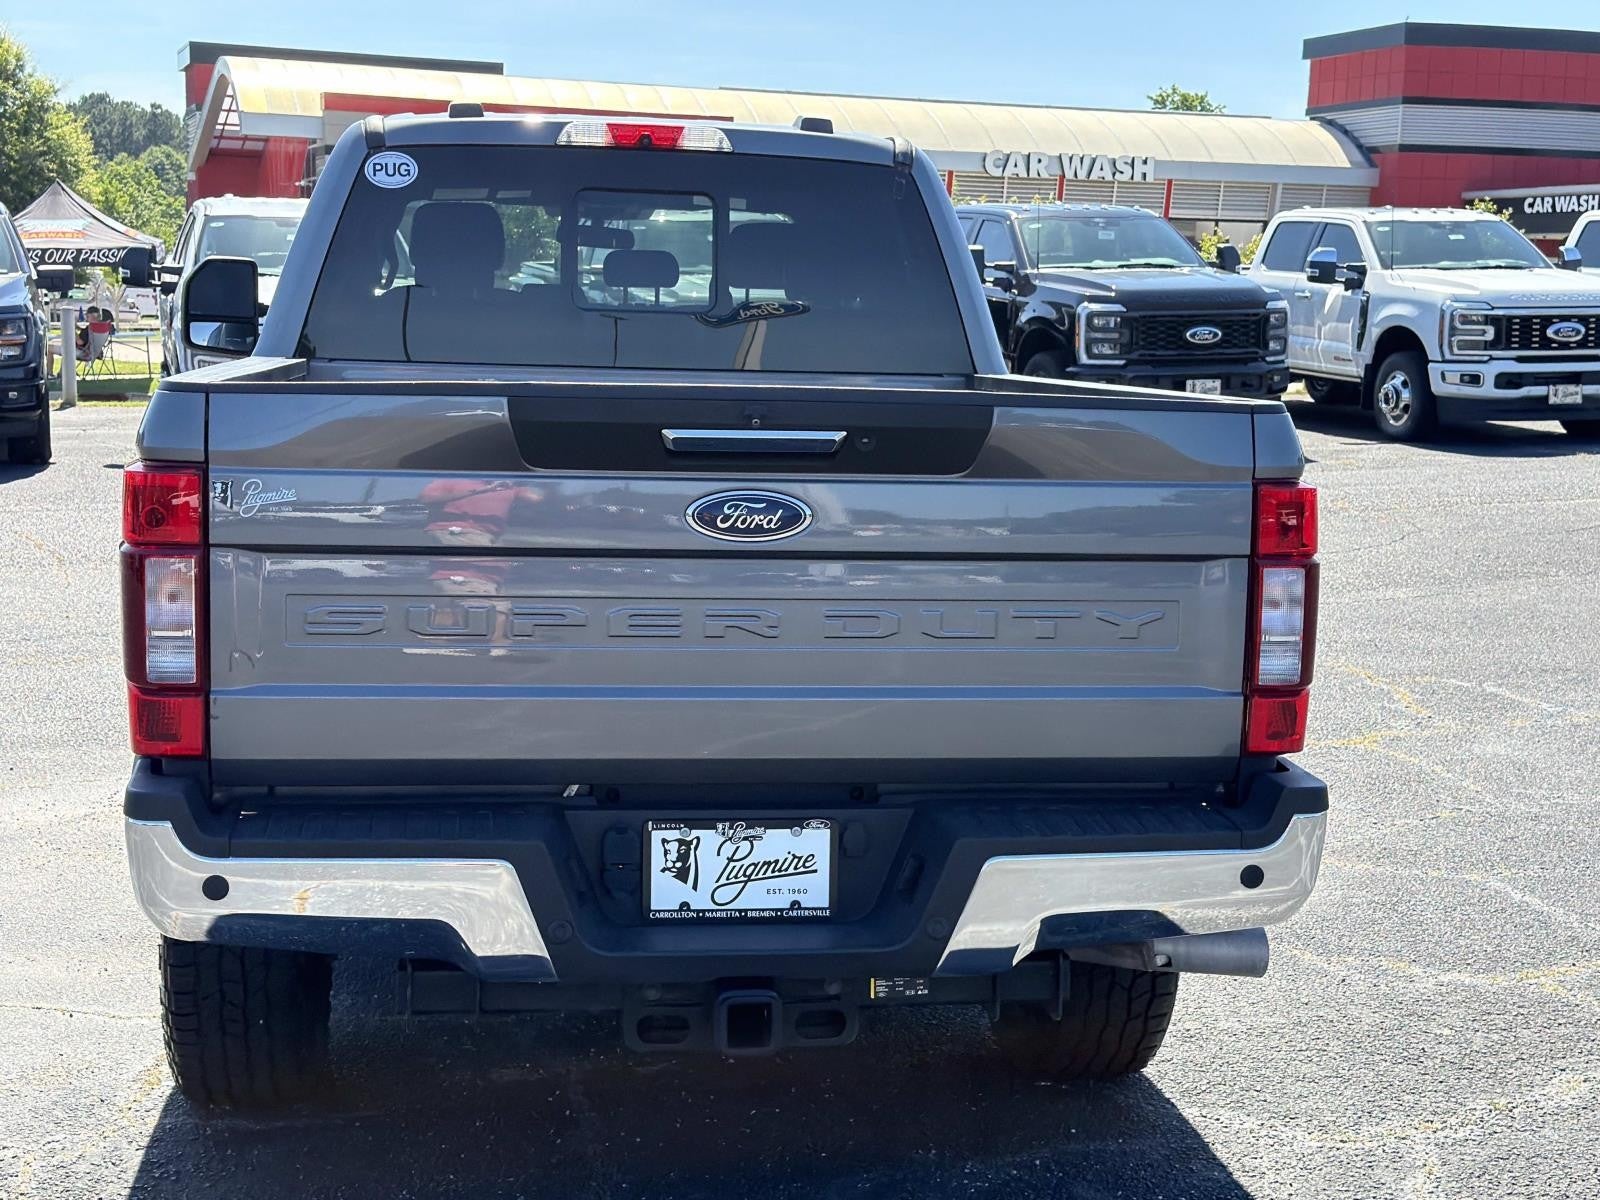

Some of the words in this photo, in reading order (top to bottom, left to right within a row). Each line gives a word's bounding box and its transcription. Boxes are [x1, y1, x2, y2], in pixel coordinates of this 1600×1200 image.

[372, 162, 411, 177] PUG
[984, 150, 1050, 178] CAR
[1060, 153, 1155, 181] WASH
[1524, 196, 1553, 214] CAR
[1554, 194, 1600, 213] WASH
[45, 249, 77, 263] OUR
[240, 479, 297, 517] Pugmire
[716, 501, 783, 529] Ford
[303, 604, 782, 639] SUPER
[823, 608, 1166, 640] DUTY
[710, 838, 818, 907] Pugmire
[650, 911, 697, 919] CARROLLTON
